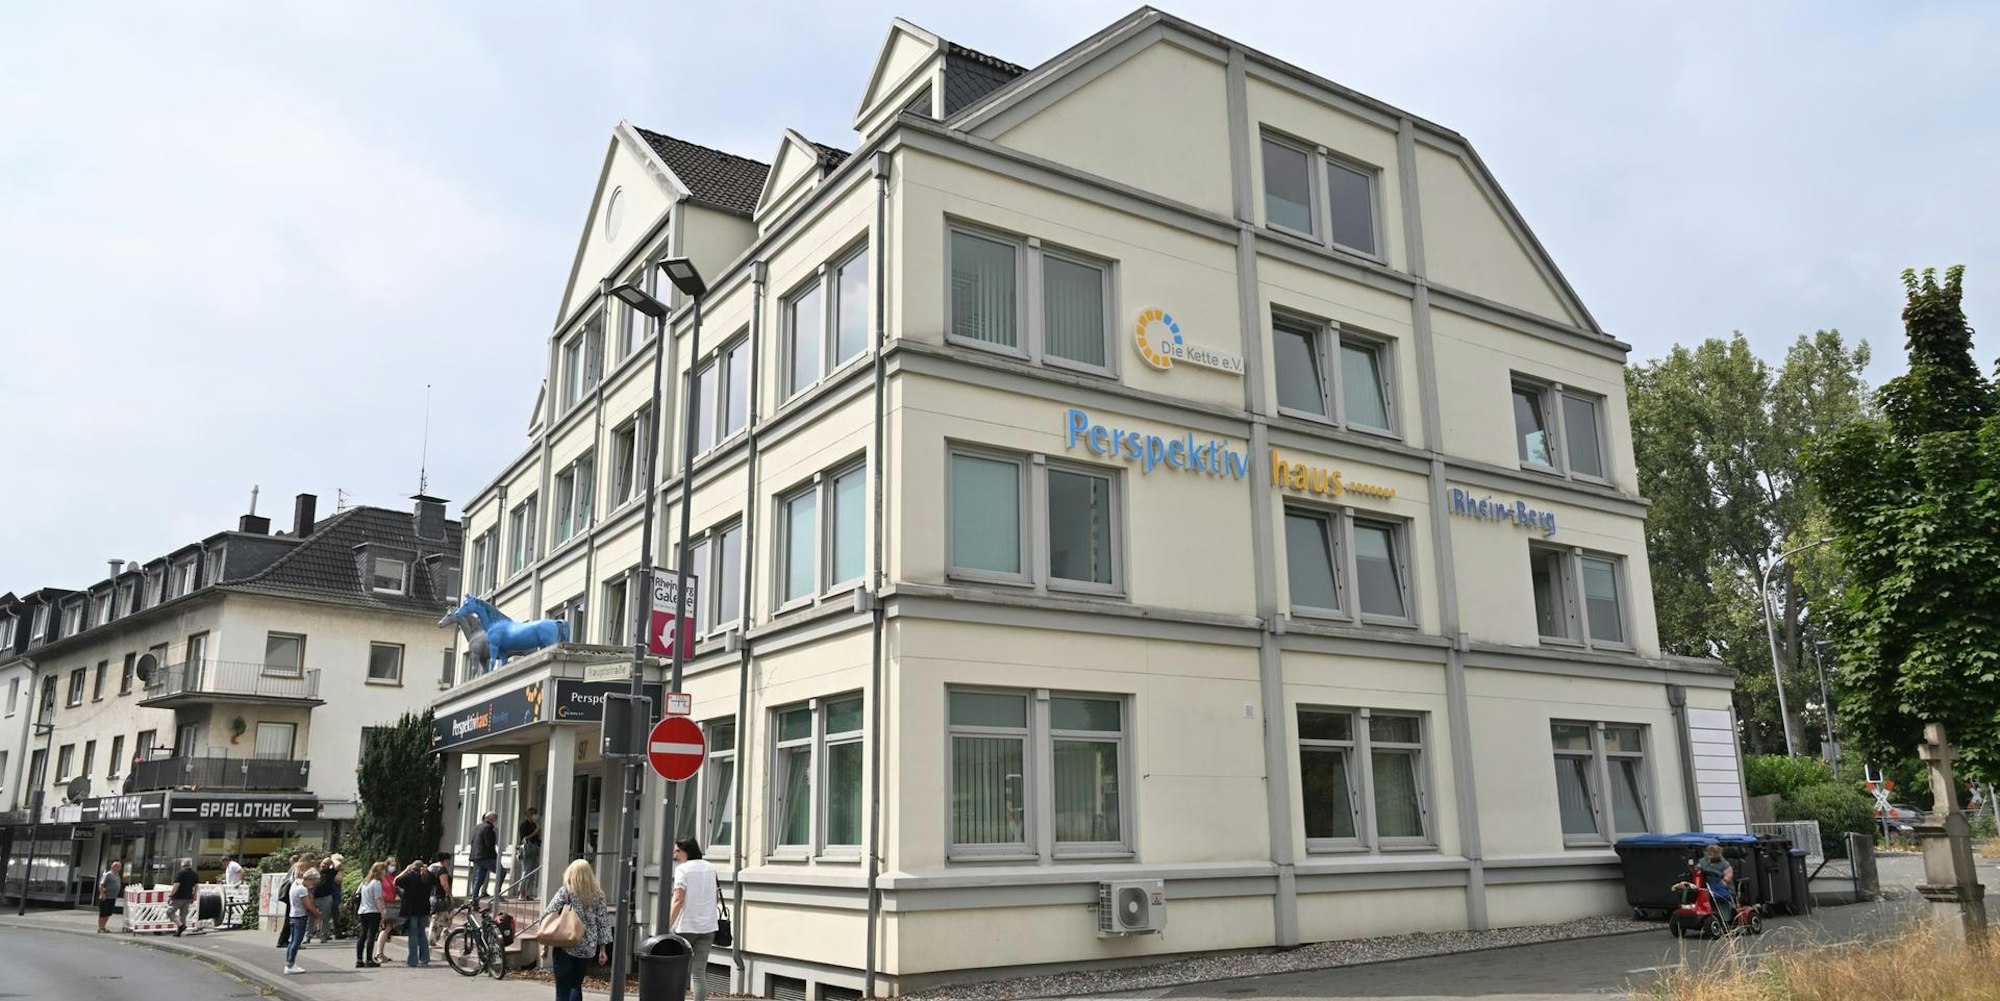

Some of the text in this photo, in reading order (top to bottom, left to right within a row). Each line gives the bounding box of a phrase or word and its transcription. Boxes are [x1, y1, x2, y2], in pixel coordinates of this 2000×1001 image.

[1161, 340, 1242, 371] Die Kette e.V.
[1066, 408, 1249, 480] Perspektiv
[1451, 486, 1556, 536] Rhein-Berg
[571, 692, 605, 706] Perspe
[99, 795, 141, 819] SPIELOTHEK
[200, 802, 291, 818] SPIELOTHEK
